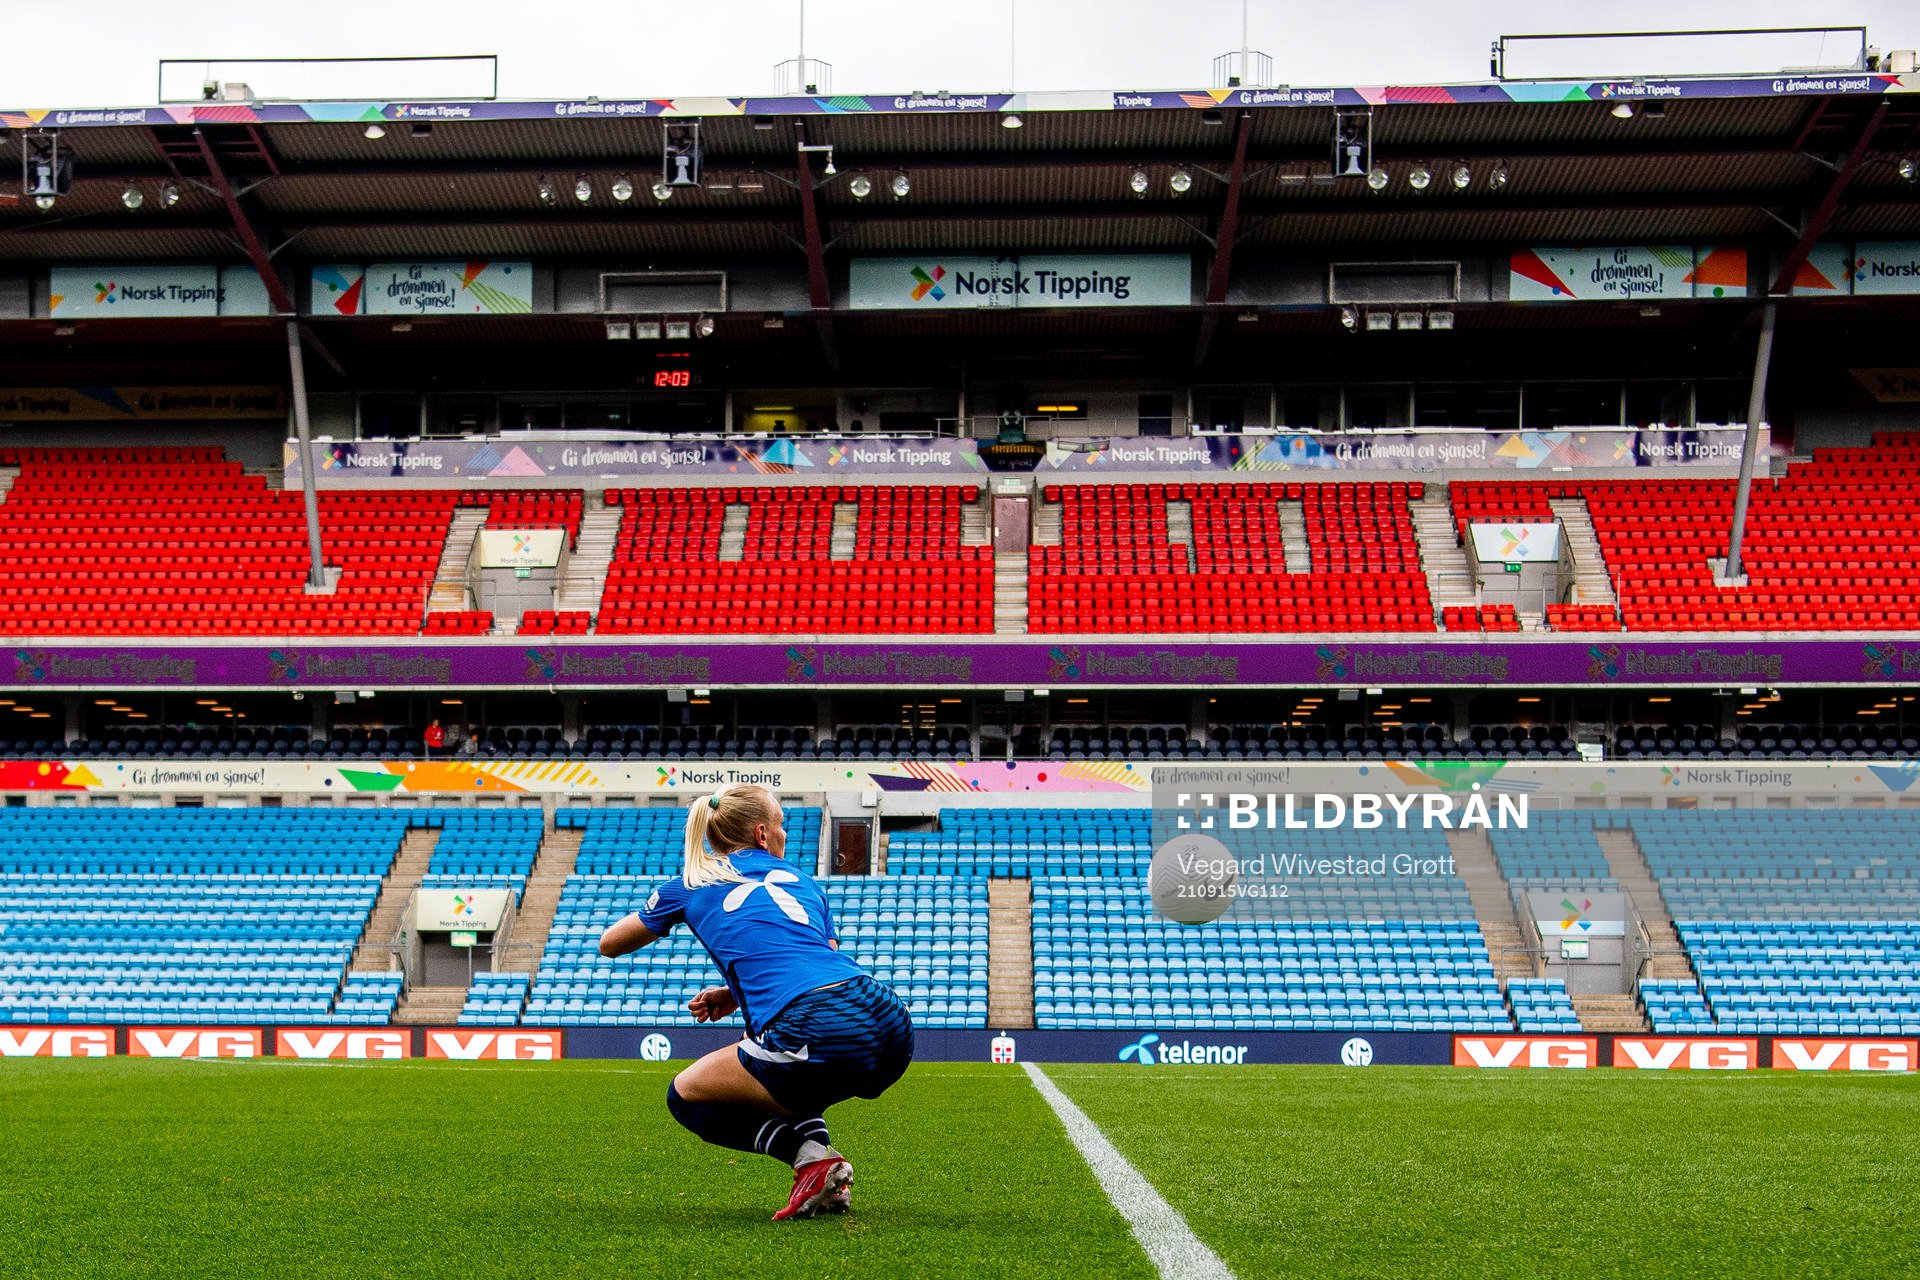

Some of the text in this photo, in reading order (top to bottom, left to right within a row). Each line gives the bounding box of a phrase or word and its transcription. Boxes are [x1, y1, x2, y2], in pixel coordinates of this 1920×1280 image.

[1618, 85, 1681, 97] Norsk Tipping
[1772, 80, 1784, 92] Gi
[1825, 80, 1837, 90] en
[1839, 77, 1870, 92] sjanse!
[1118, 96, 1152, 108] Tipping
[410, 107, 471, 118] Norsk Tipping
[1614, 249, 1627, 265] Gi
[408, 265, 422, 280] Gi
[1591, 258, 1653, 284] drømmen
[1872, 261, 1920, 277] Norsk
[122, 285, 226, 303] Norsk Tipping
[387, 274, 445, 297] drømmen
[955, 270, 1130, 299] Norsk Tipping
[1603, 272, 1664, 299] en sjanse!
[399, 288, 455, 313] en sjanse!
[655, 370, 690, 387] 12:03
[562, 447, 707, 468] Gi drømmen en sjanse!
[853, 449, 952, 466] Norsk Tipping
[1112, 447, 1211, 465] Norsk Tipping
[1336, 440, 1486, 462] Gi drømmen en sjanse!
[1639, 442, 1742, 459] Norsk Tipping
[346, 453, 443, 469] Norsk Tipping
[132, 768, 265, 788] Gi drømmen en sjanse!
[682, 770, 781, 786] Norsk Tipping
[1150, 767, 1290, 787] Gi drømmen en sjanse!
[1687, 770, 1792, 786] Norsk Tipping
[439, 919, 487, 930] Norsk Tipping
[0, 1031, 107, 1057] VG
[135, 1031, 254, 1058] VG
[282, 1032, 402, 1059] VG
[431, 1033, 552, 1060] VG
[1158, 1040, 1248, 1065] telenor
[1460, 1040, 1588, 1068] VG
[1620, 1041, 1748, 1070] VG
[1780, 1042, 1908, 1071] VG
